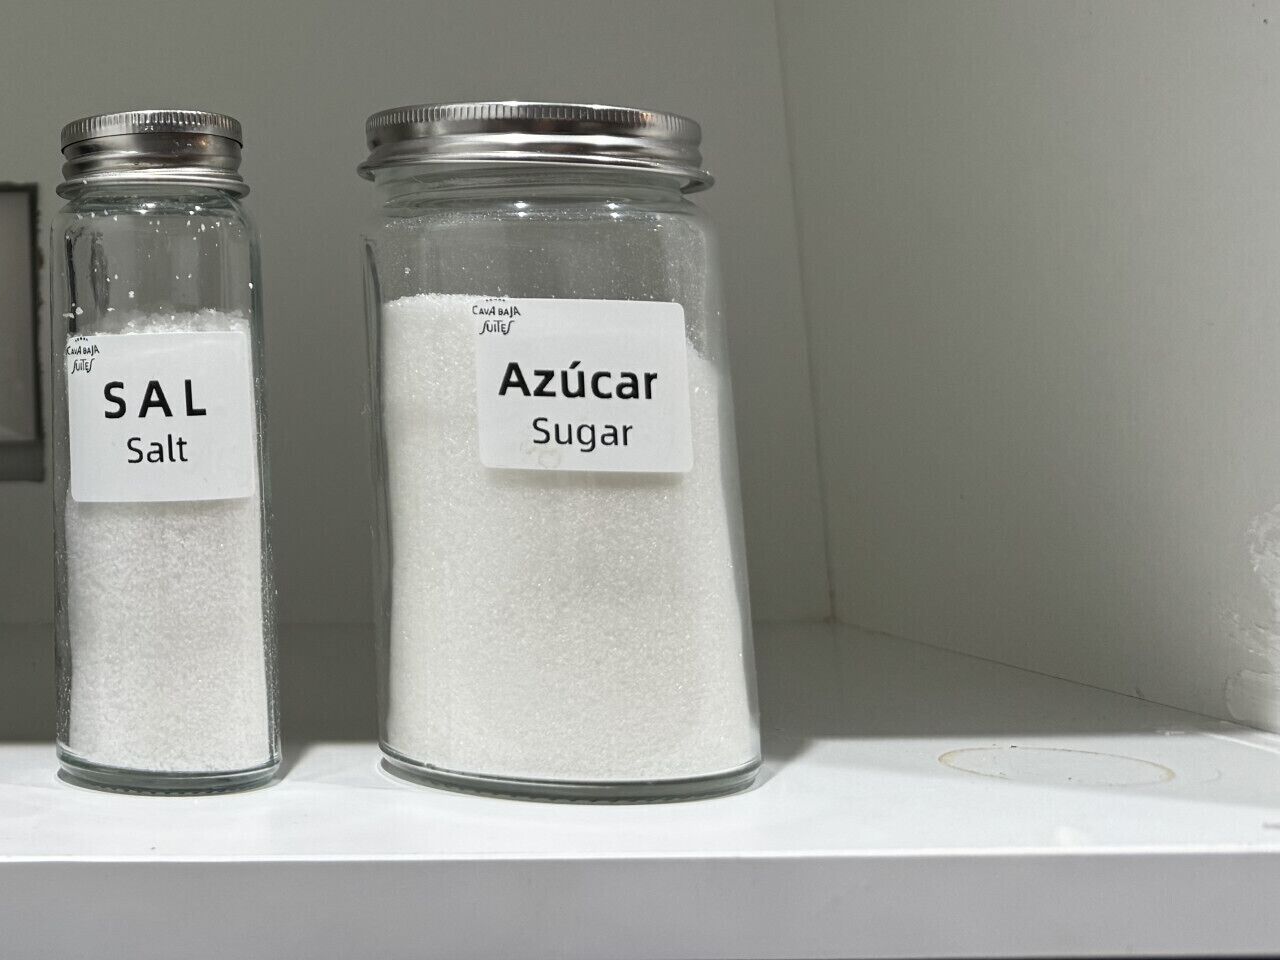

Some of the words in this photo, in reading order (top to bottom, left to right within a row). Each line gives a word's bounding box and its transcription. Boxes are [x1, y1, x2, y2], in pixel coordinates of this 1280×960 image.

[472, 305, 496, 316] CAVA
[498, 306, 521, 318] BAJA
[479, 320, 515, 335] SUITES
[82, 345, 100, 356] BAJA
[71, 358, 95, 374] SUITES
[498, 360, 658, 400] Azúcar
[103, 379, 207, 419] SAL
[532, 417, 633, 453] Sugar
[126, 433, 189, 464] Salt
